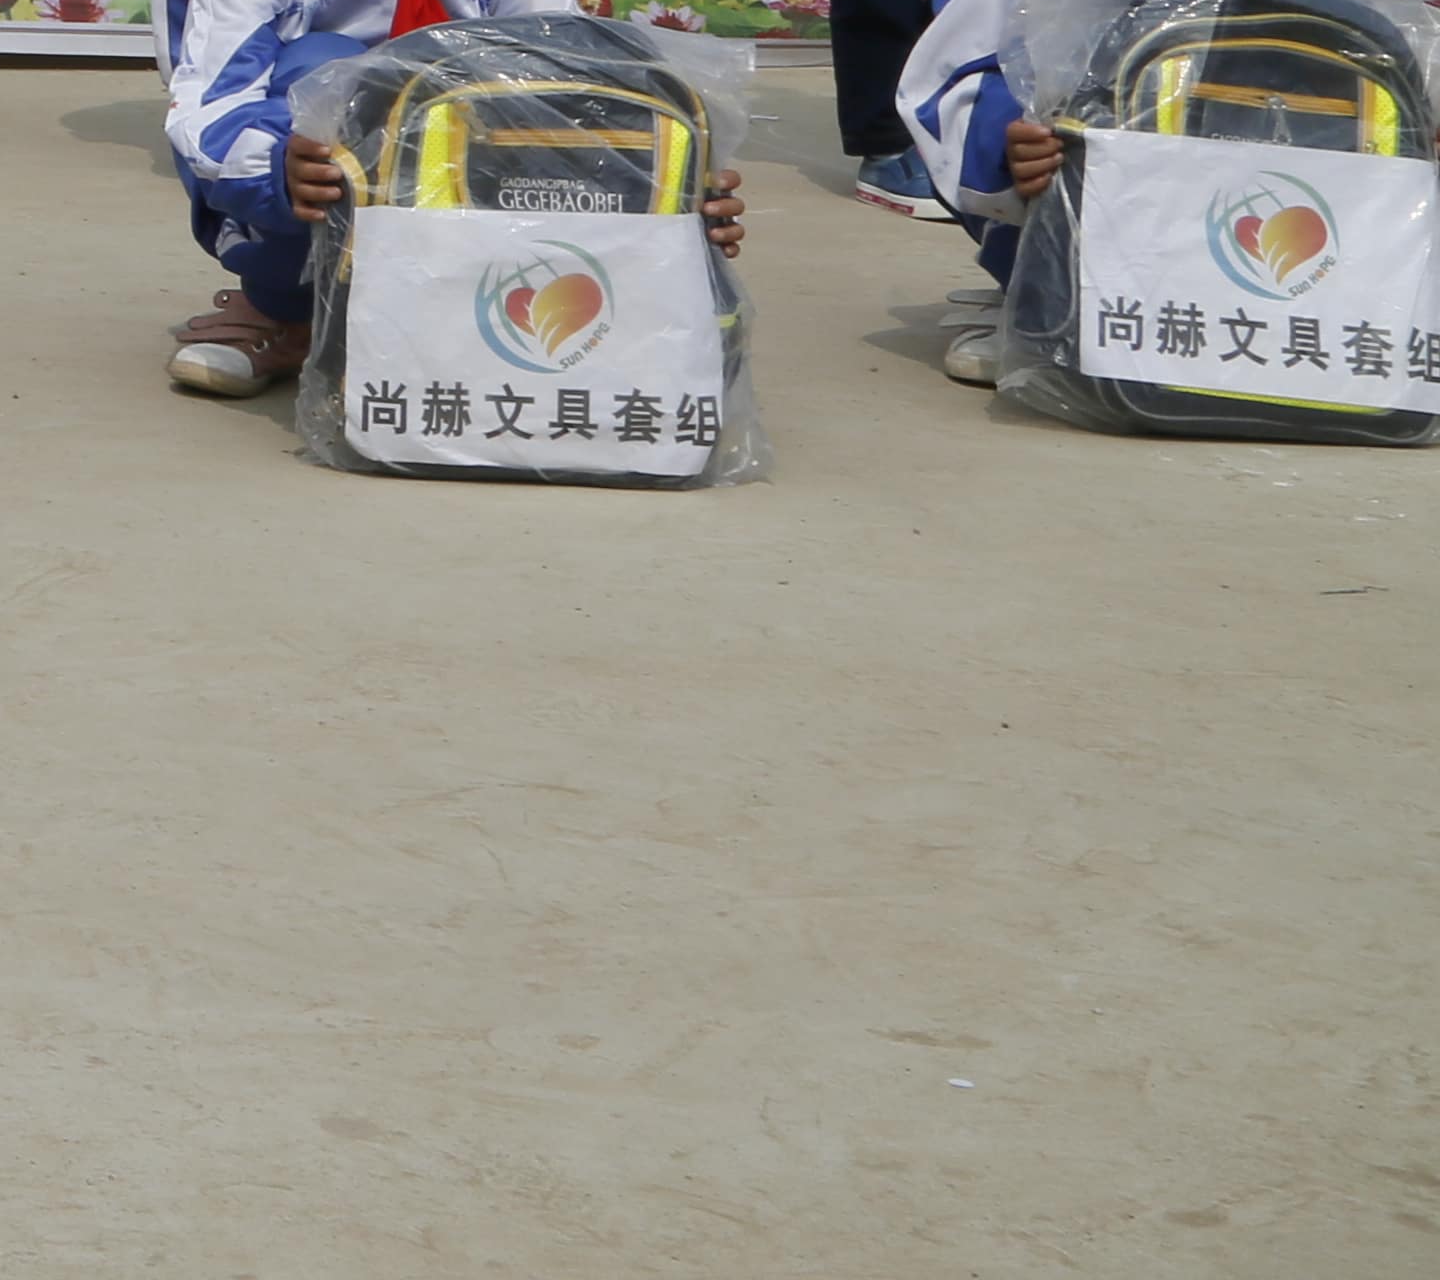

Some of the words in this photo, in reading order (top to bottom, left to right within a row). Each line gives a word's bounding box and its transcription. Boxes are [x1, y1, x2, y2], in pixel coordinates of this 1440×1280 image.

[498, 188, 623, 213] GEGEBAOBEI
[1097, 295, 1440, 384] 尚赫文具套组
[360, 380, 722, 448] 尚赫文具套组
